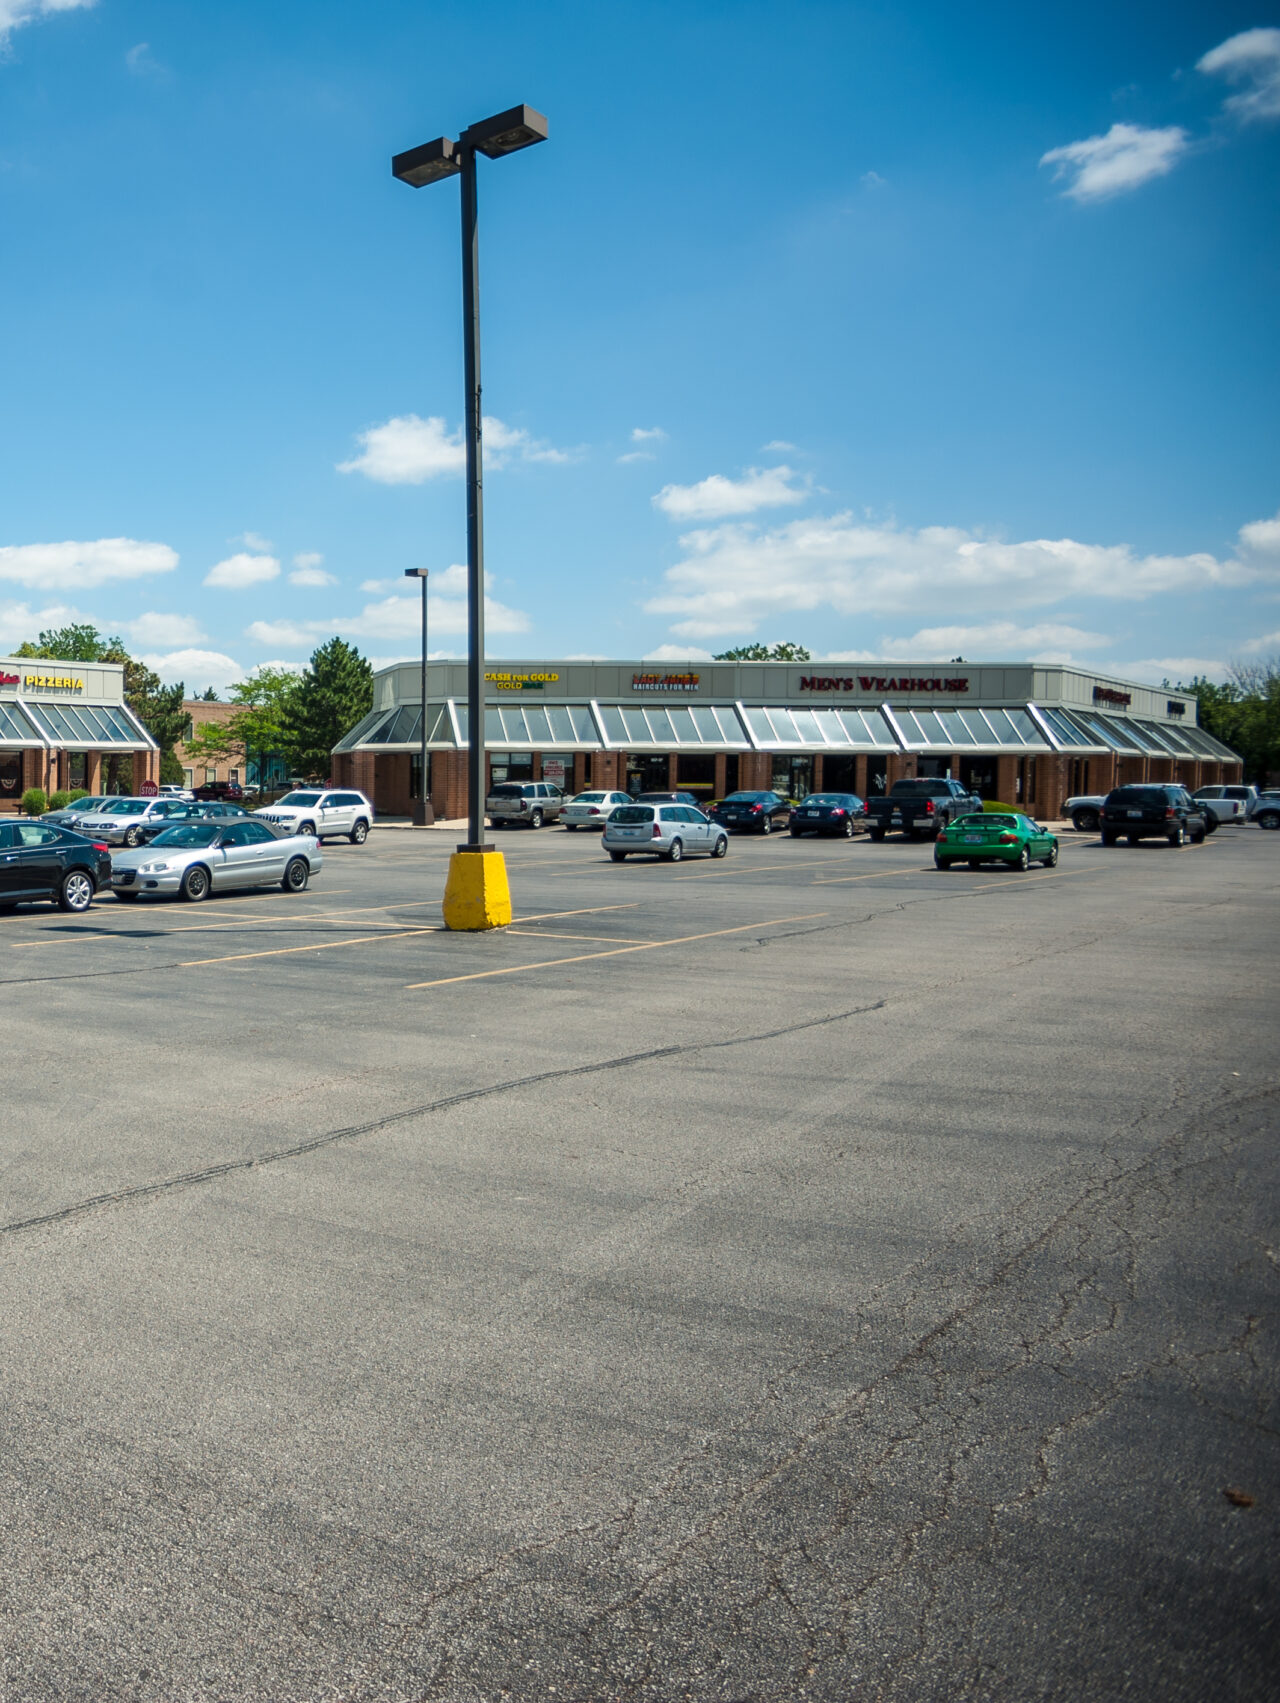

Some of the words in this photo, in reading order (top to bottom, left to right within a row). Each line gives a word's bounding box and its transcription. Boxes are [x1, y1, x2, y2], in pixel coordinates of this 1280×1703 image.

[25, 675, 84, 689] PIZZERIA
[484, 672, 510, 682] CASH
[530, 672, 559, 682] GOLD
[857, 676, 968, 692] WEARHOUSE
[141, 786, 158, 796] STOP
